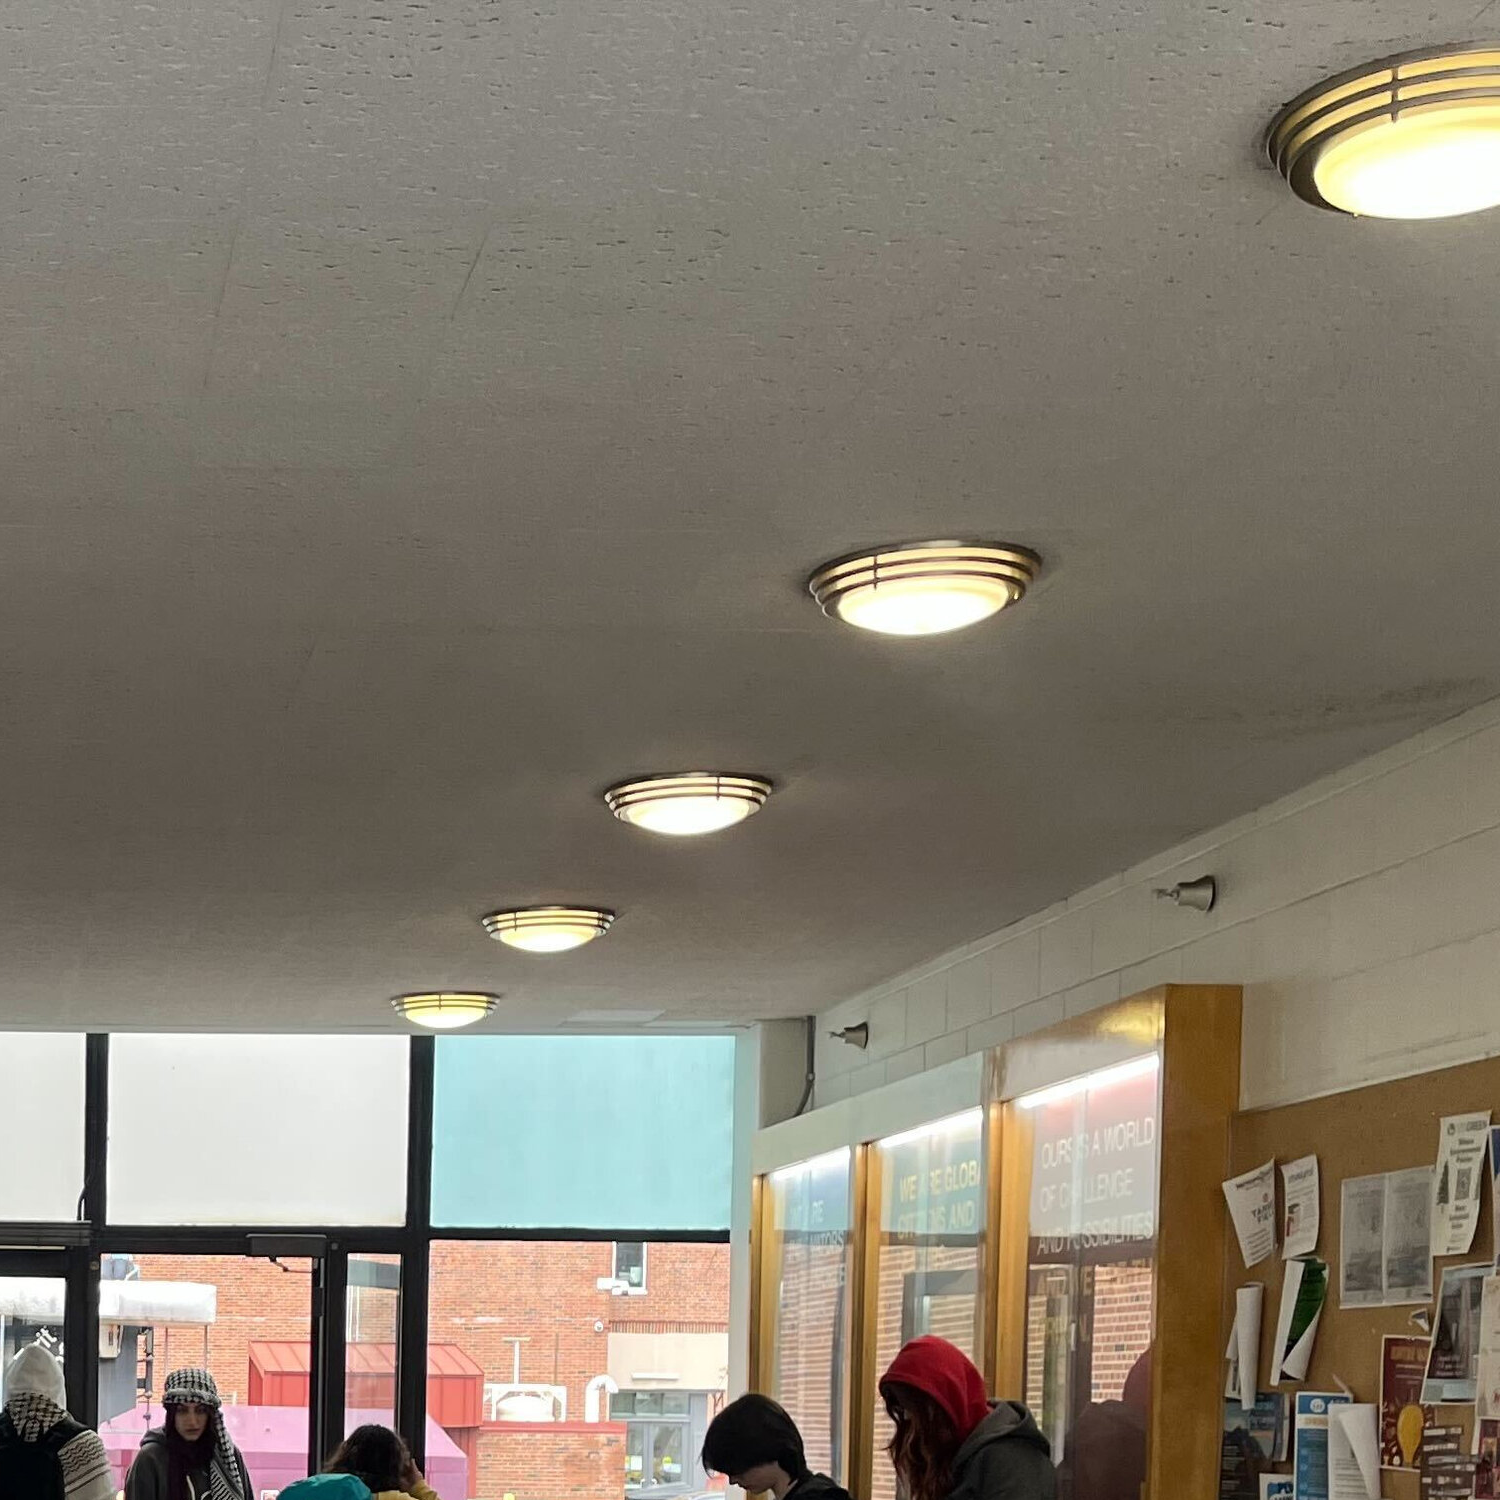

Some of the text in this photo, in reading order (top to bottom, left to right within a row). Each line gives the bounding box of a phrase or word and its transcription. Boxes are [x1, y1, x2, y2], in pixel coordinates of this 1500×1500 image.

[1091, 1130, 1101, 1157] A
[1104, 1117, 1155, 1154] WORLD
[1039, 1167, 1134, 1212] OF CLLENGE
